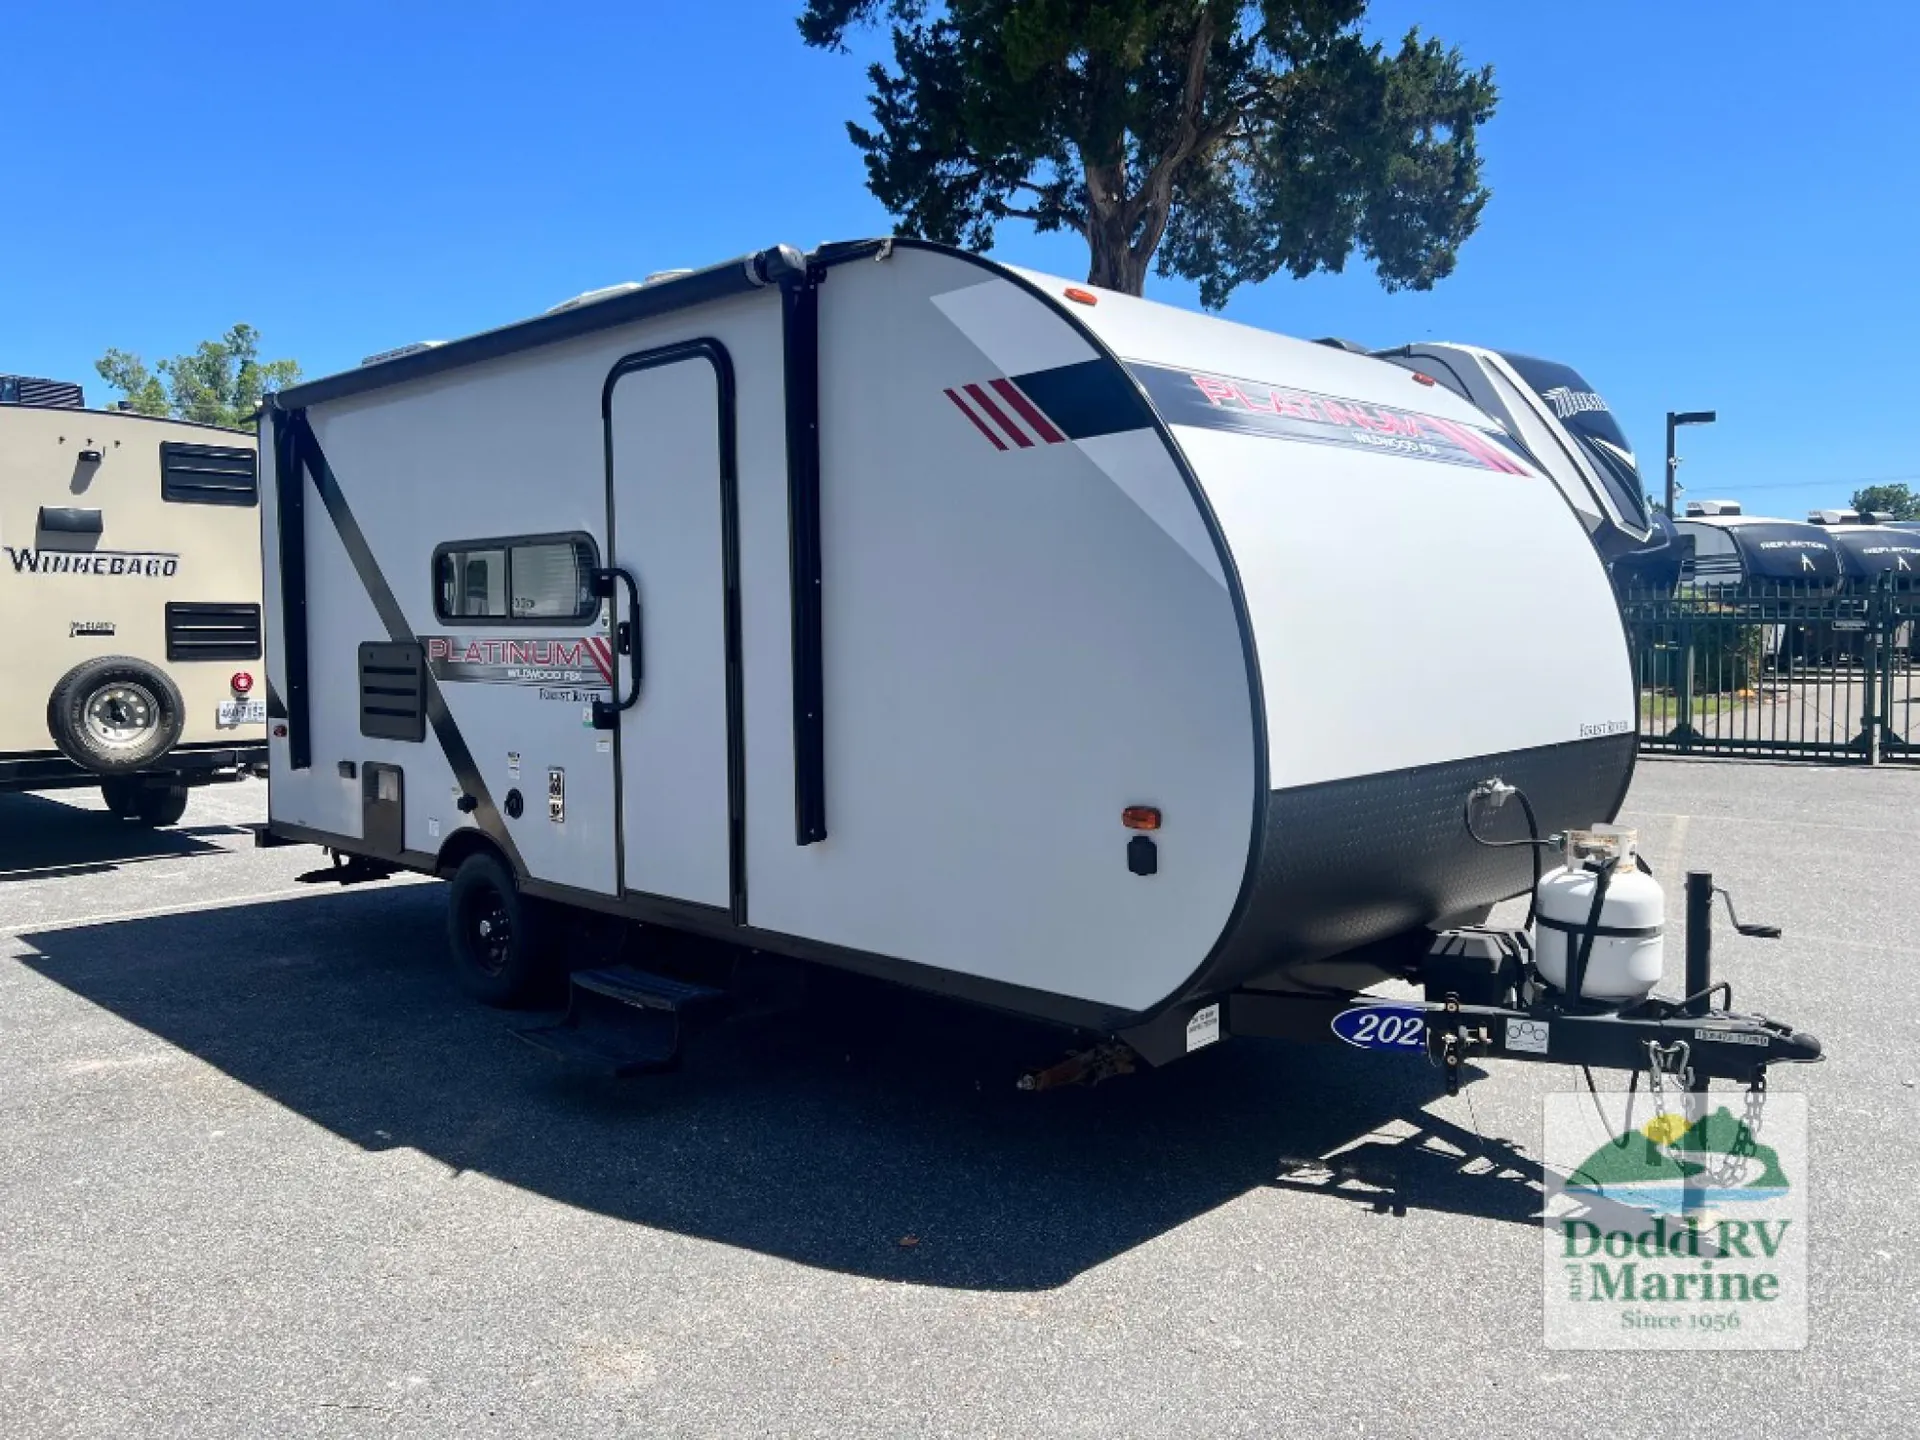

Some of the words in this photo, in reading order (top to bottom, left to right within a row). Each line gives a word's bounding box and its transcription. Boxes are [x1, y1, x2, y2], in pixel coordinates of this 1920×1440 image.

[1190, 375, 1424, 437] PLATINUM
[1760, 540, 1828, 550] REFLECTION
[3, 547, 180, 577] WINNEBAGO
[428, 639, 582, 667] PLATINUM
[507, 668, 561, 680] WILDWOOD
[1352, 1014, 1426, 1045] 202
